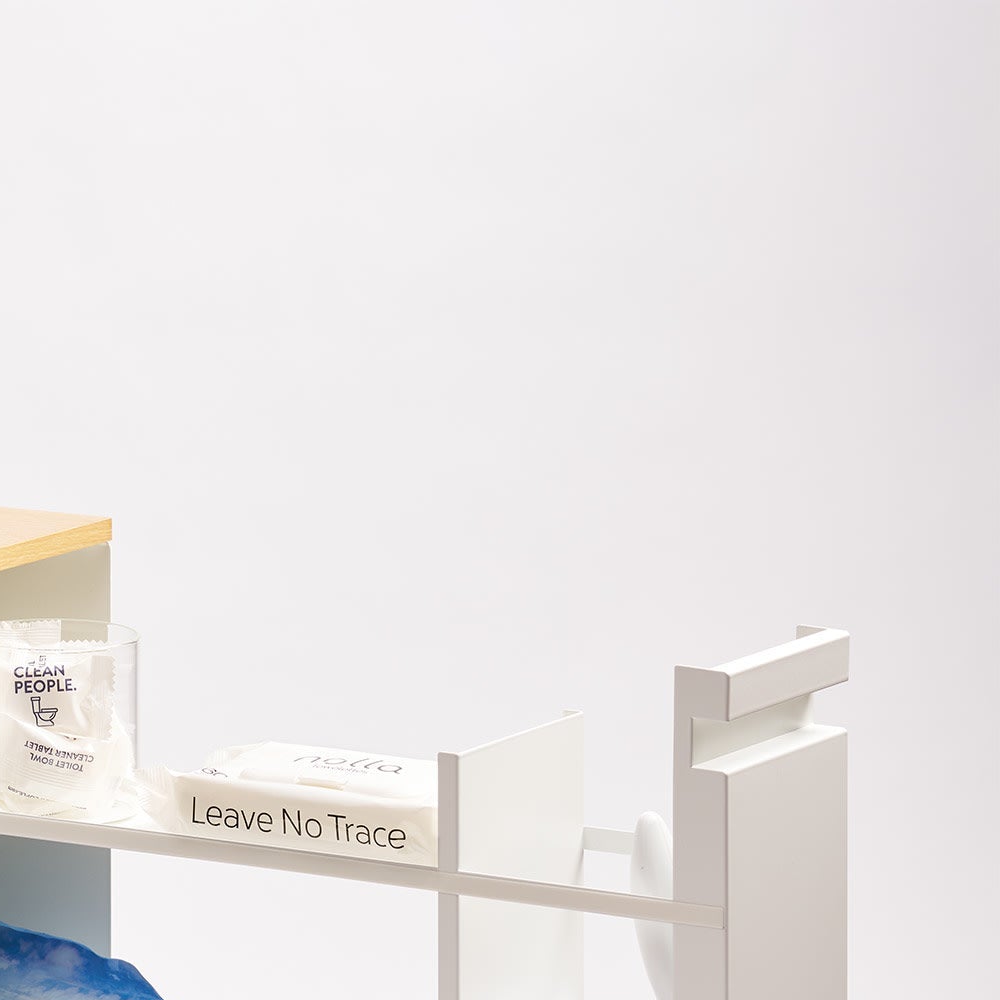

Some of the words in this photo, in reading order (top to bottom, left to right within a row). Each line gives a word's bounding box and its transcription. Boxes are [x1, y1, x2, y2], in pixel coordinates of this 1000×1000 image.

[14, 665, 65, 678] CLEAN
[14, 679, 77, 694] PEOPLE.
[24, 740, 53, 755] TABLET
[29, 752, 54, 766] BOWL
[55, 749, 94, 763] CLEANER
[55, 760, 83, 772] TOILET
[294, 755, 403, 775] nolla
[192, 796, 273, 833] Leave
[282, 807, 322, 838] No
[327, 813, 406, 849] Trace
